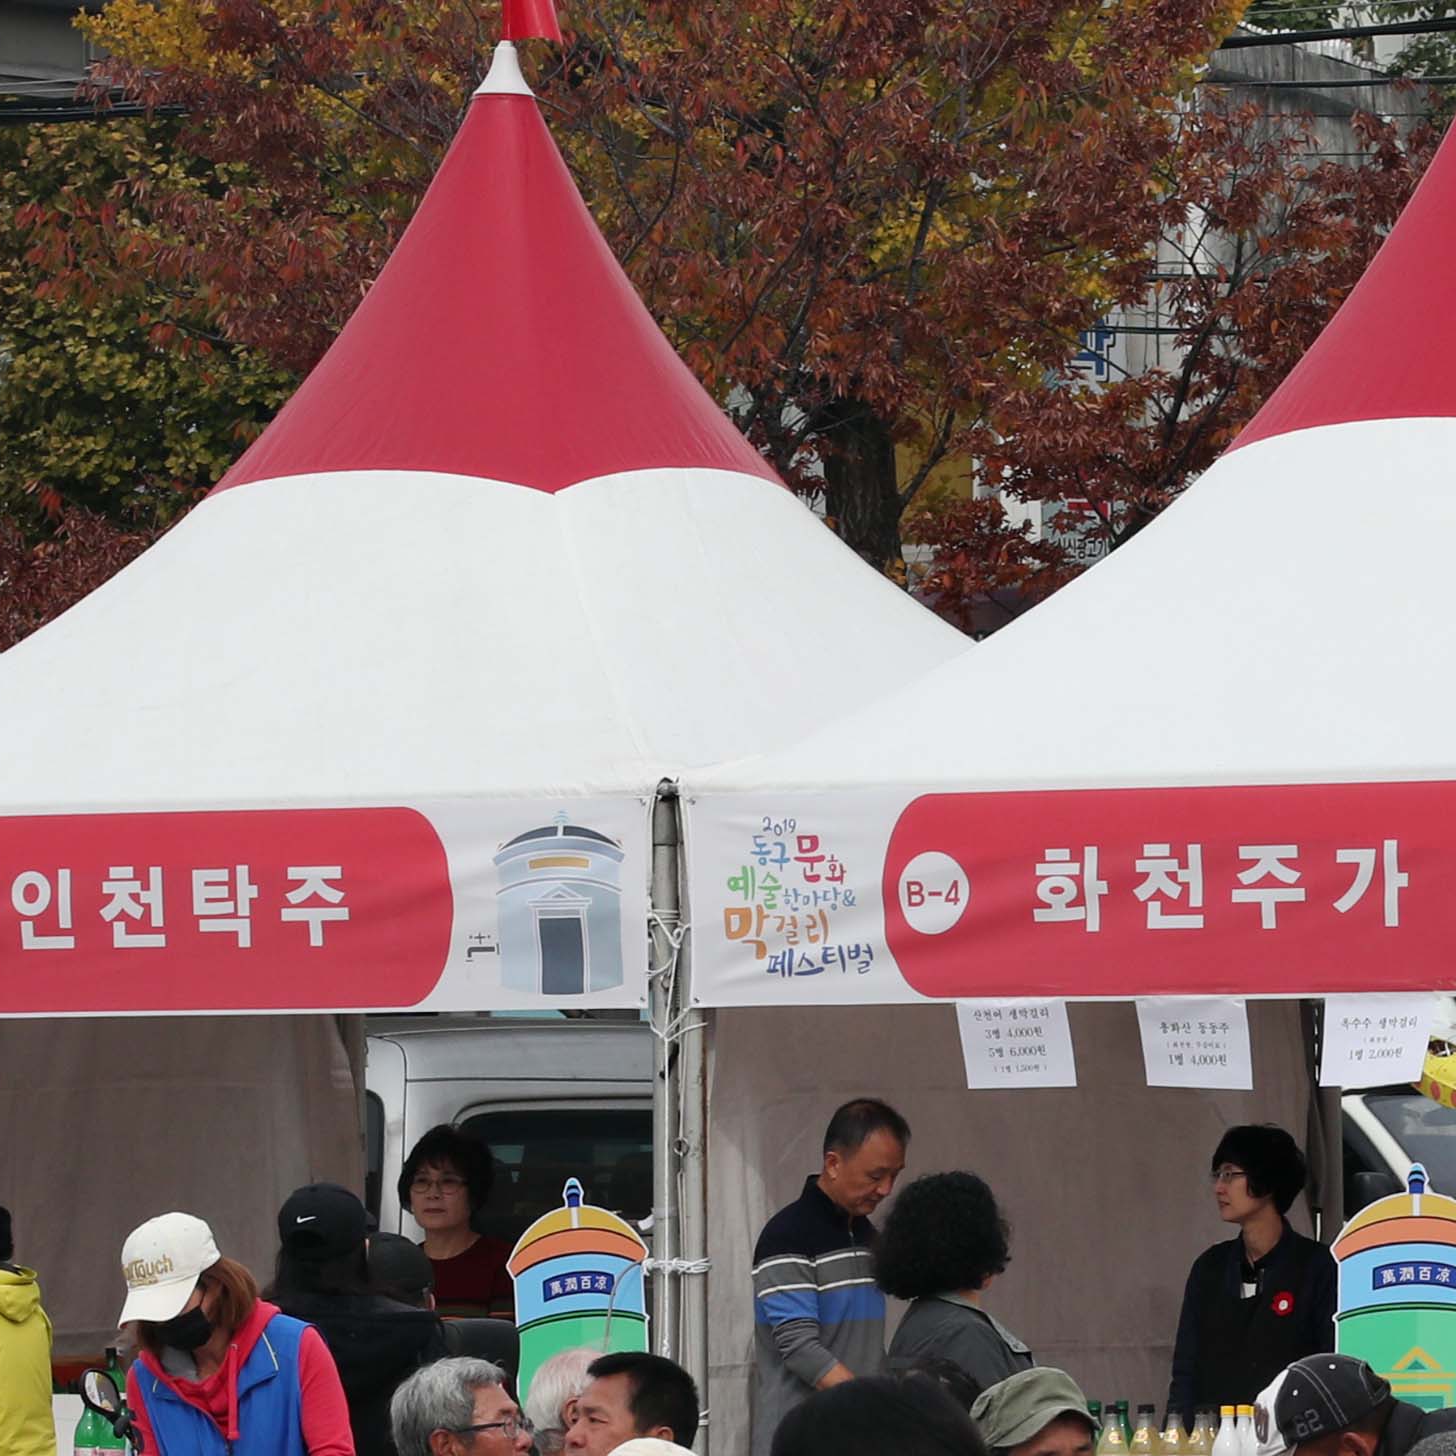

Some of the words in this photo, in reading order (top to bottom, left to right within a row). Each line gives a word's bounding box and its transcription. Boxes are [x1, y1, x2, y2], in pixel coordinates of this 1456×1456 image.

[762, 816, 796, 836] 2019
[11, 864, 350, 950] 인천탁주
[906, 880, 960, 907] B-4
[1033, 839, 1408, 932] 화천주가
[724, 904, 829, 960] 막걸리
[766, 943, 874, 977] 페스티벌
